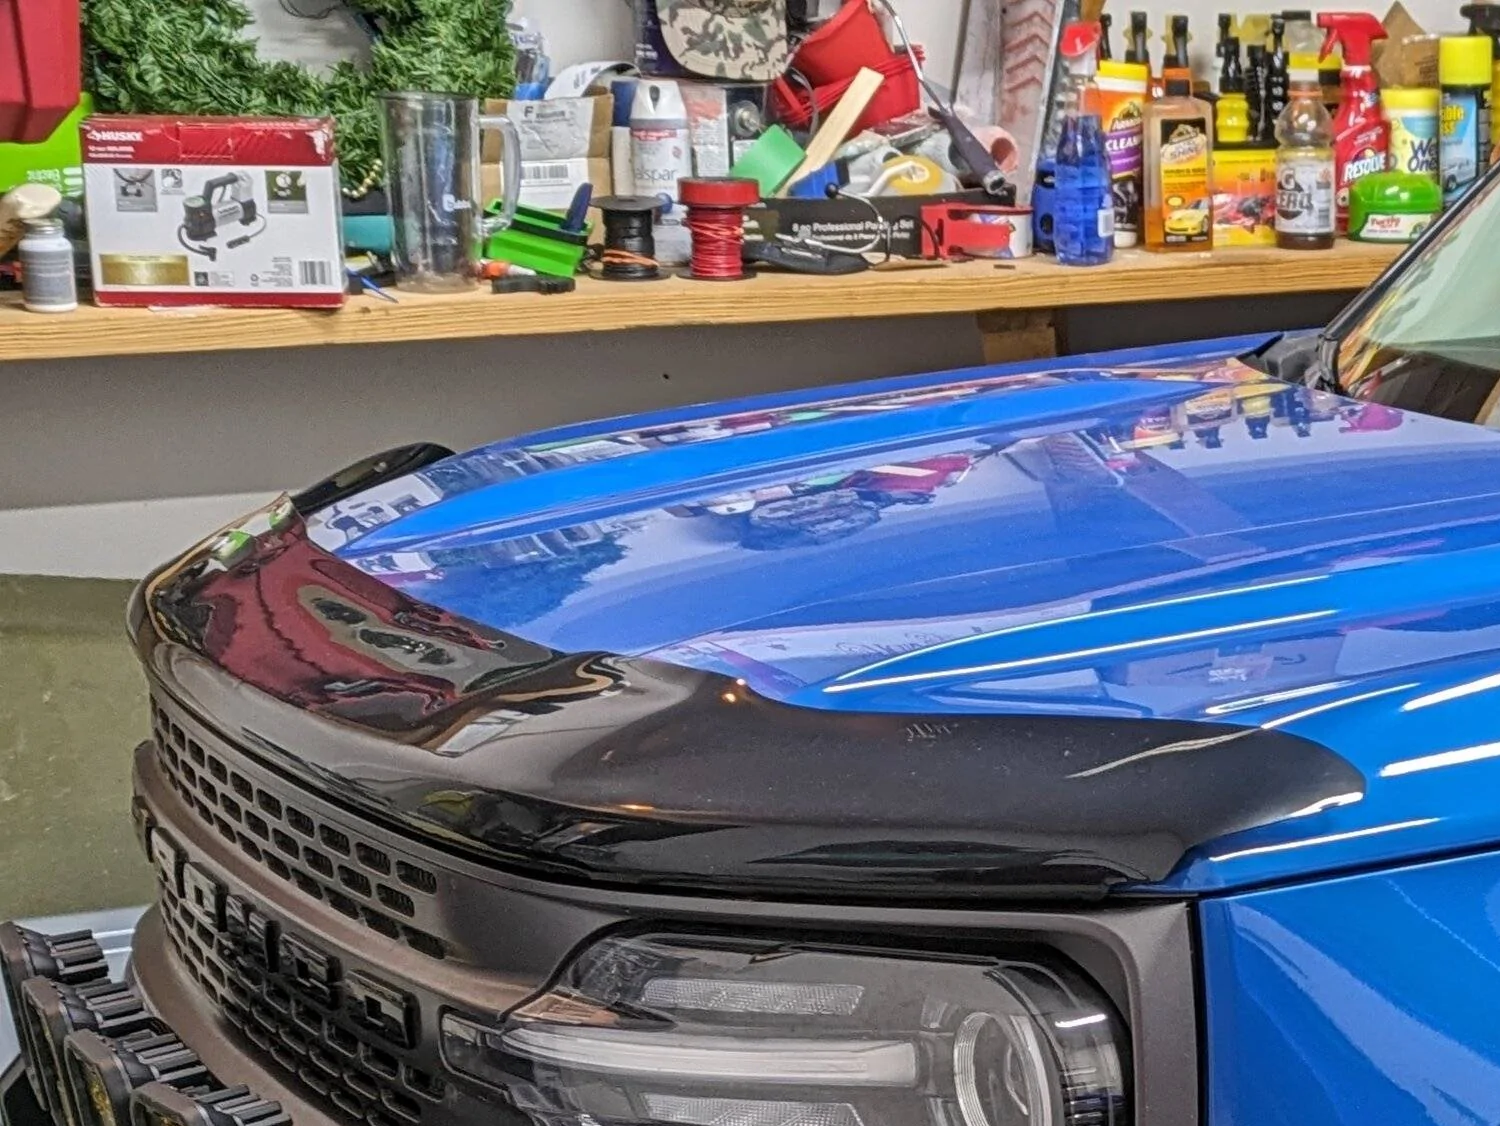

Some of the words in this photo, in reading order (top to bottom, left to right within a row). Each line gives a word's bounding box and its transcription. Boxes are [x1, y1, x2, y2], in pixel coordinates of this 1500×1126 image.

[102, 131, 143, 142] HUSKY
[1410, 138, 1439, 158] We
[1344, 152, 1386, 181] RESOLVE
[1408, 154, 1439, 172] One
[1281, 168, 1295, 190] G
[813, 221, 864, 232] Professional
[899, 219, 914, 230] Set
[143, 816, 422, 1050] RONCO
